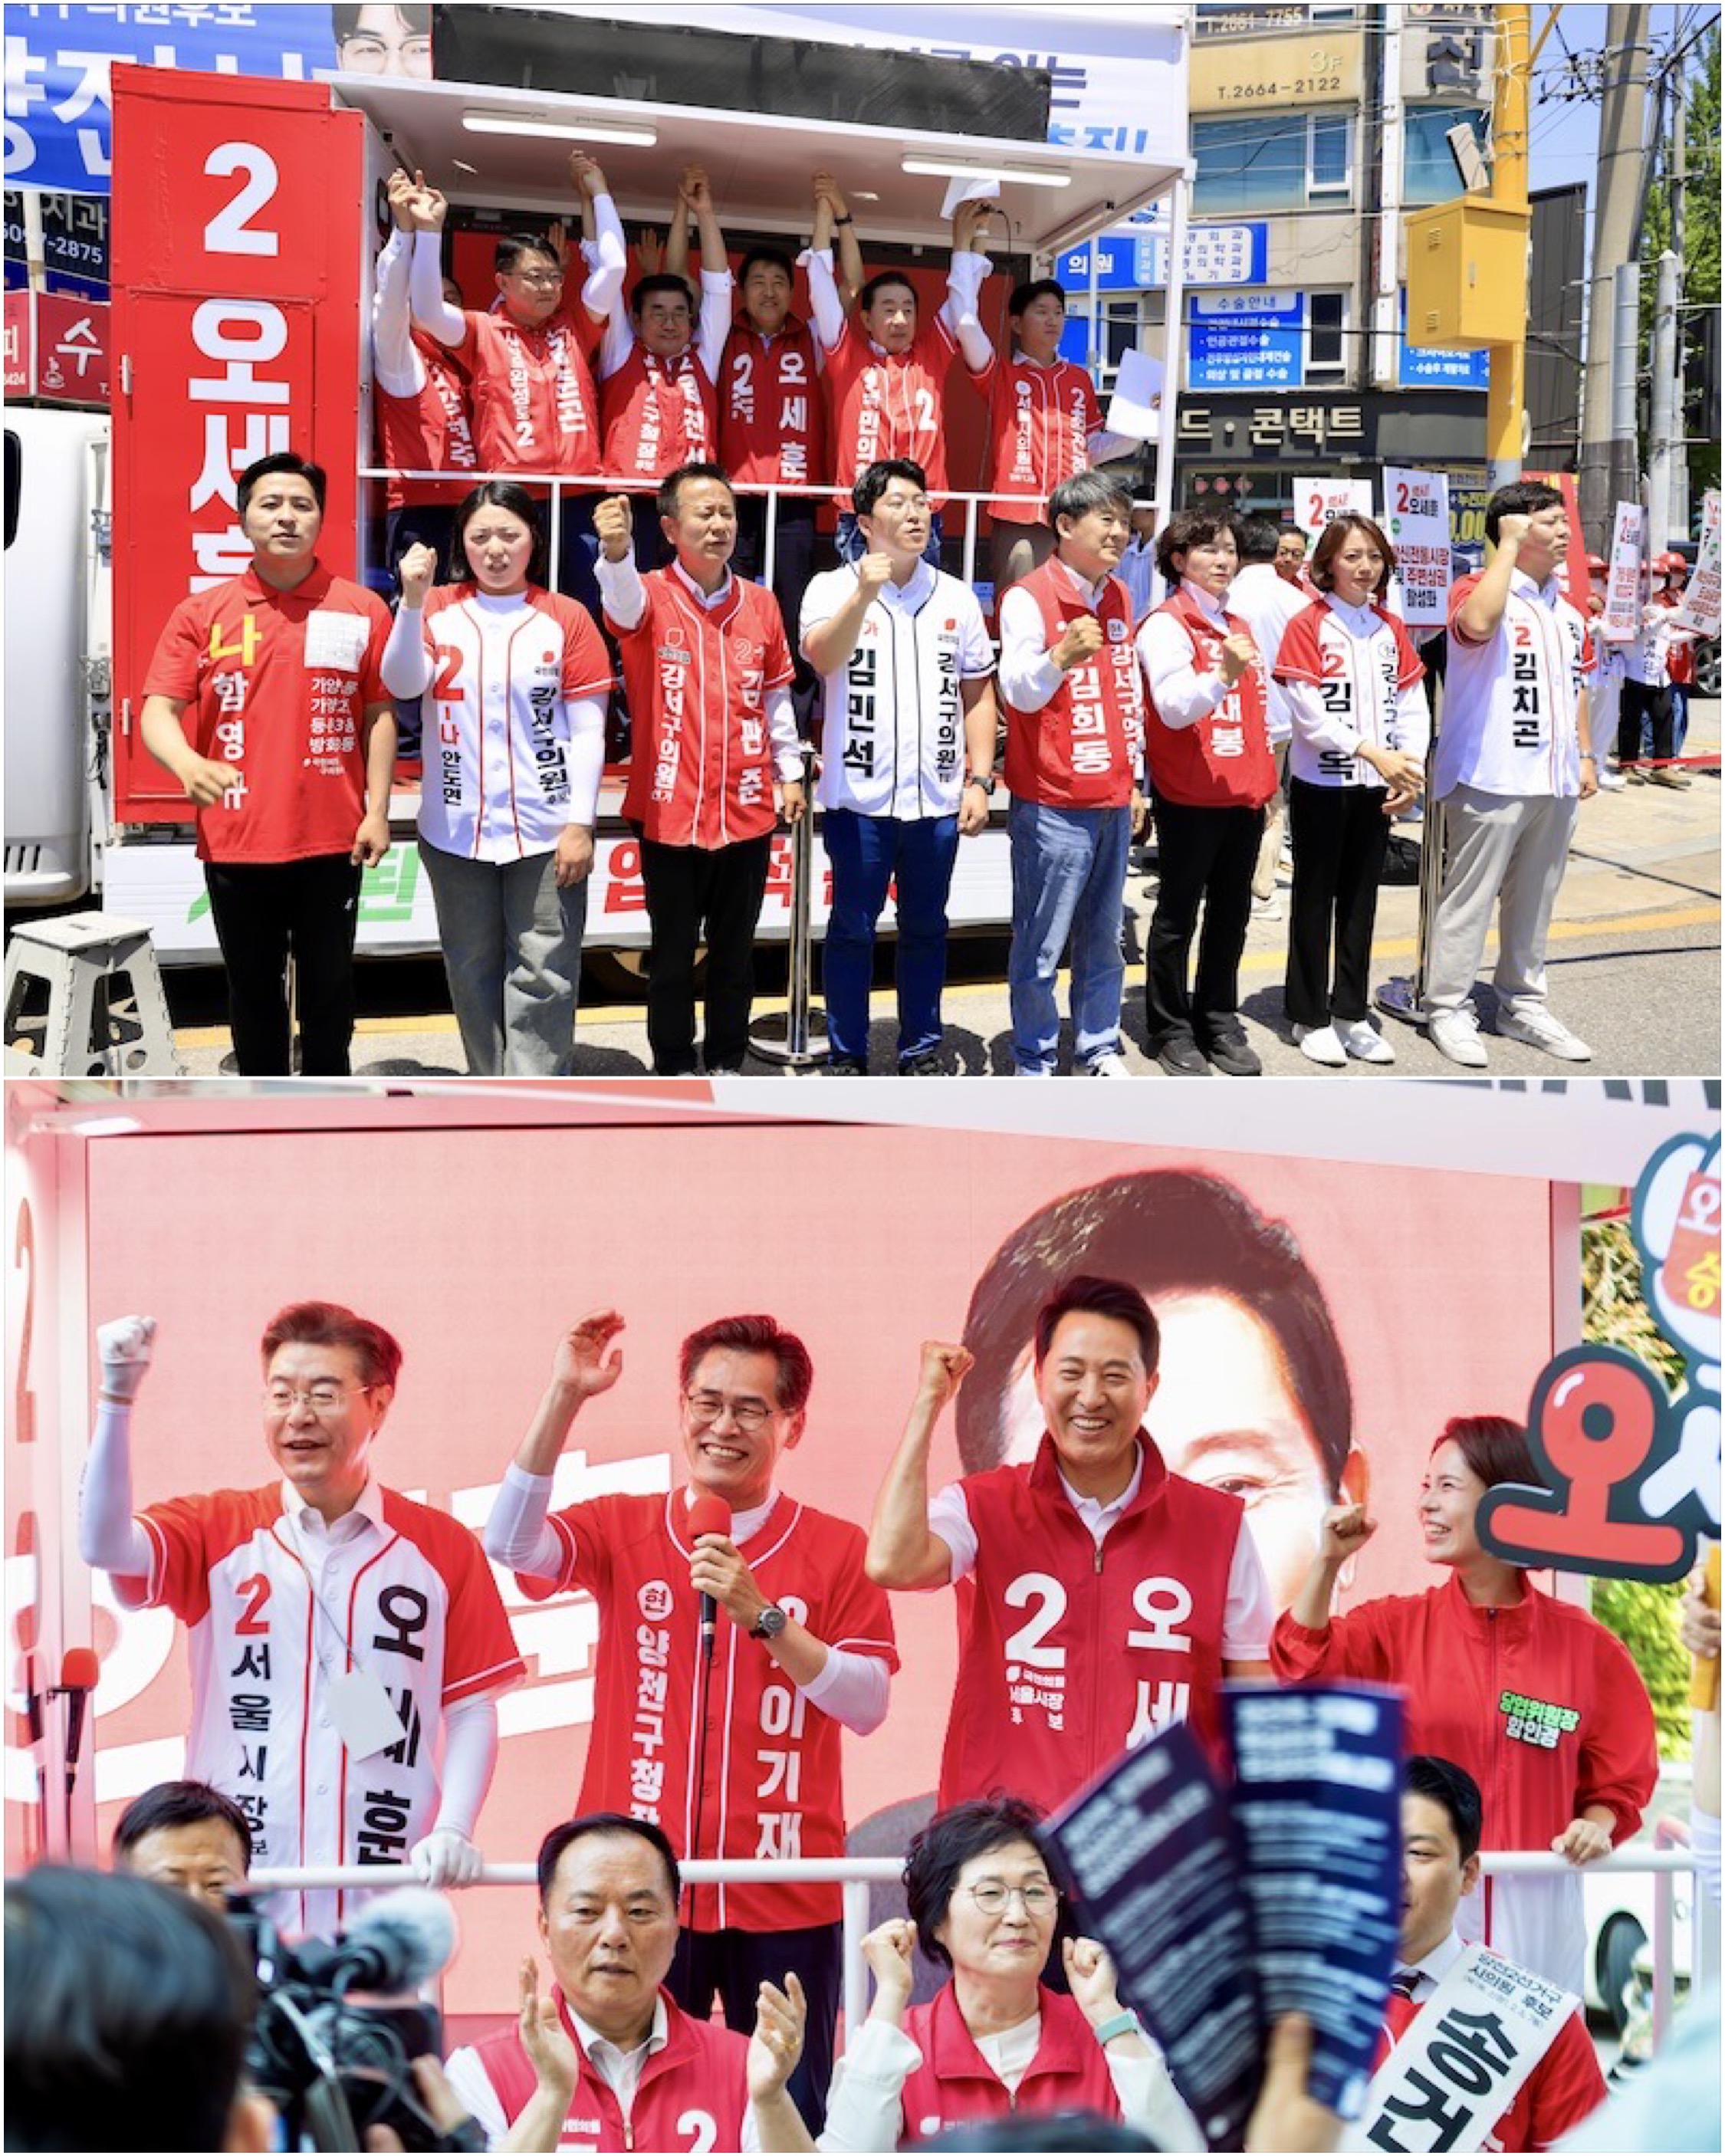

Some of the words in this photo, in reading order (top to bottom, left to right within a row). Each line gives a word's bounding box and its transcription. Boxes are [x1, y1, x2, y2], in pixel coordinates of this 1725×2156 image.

[1217, 77, 1340, 100] T.2664-2122
[203, 141, 278, 256] 2
[4, 223, 104, 263] 0-2875
[55, 318, 103, 376] 수
[778, 352, 807, 479] 오세훈
[916, 388, 938, 431] 2
[1309, 494, 1324, 527] 2
[1397, 483, 1408, 514] 2
[210, 614, 262, 667] 나
[1322, 653, 1346, 677] 2
[1515, 626, 1532, 647] 2
[843, 649, 876, 779] 김민석
[1069, 667, 1112, 774] 김희동
[1512, 652, 1539, 748] 김치곤
[1318, 682, 1355, 781] 김옥
[1490, 1360, 1684, 1565] 오
[235, 1573, 272, 1635] 2
[1004, 1573, 1067, 1668] 2
[755, 1685, 806, 1860] 이기재
